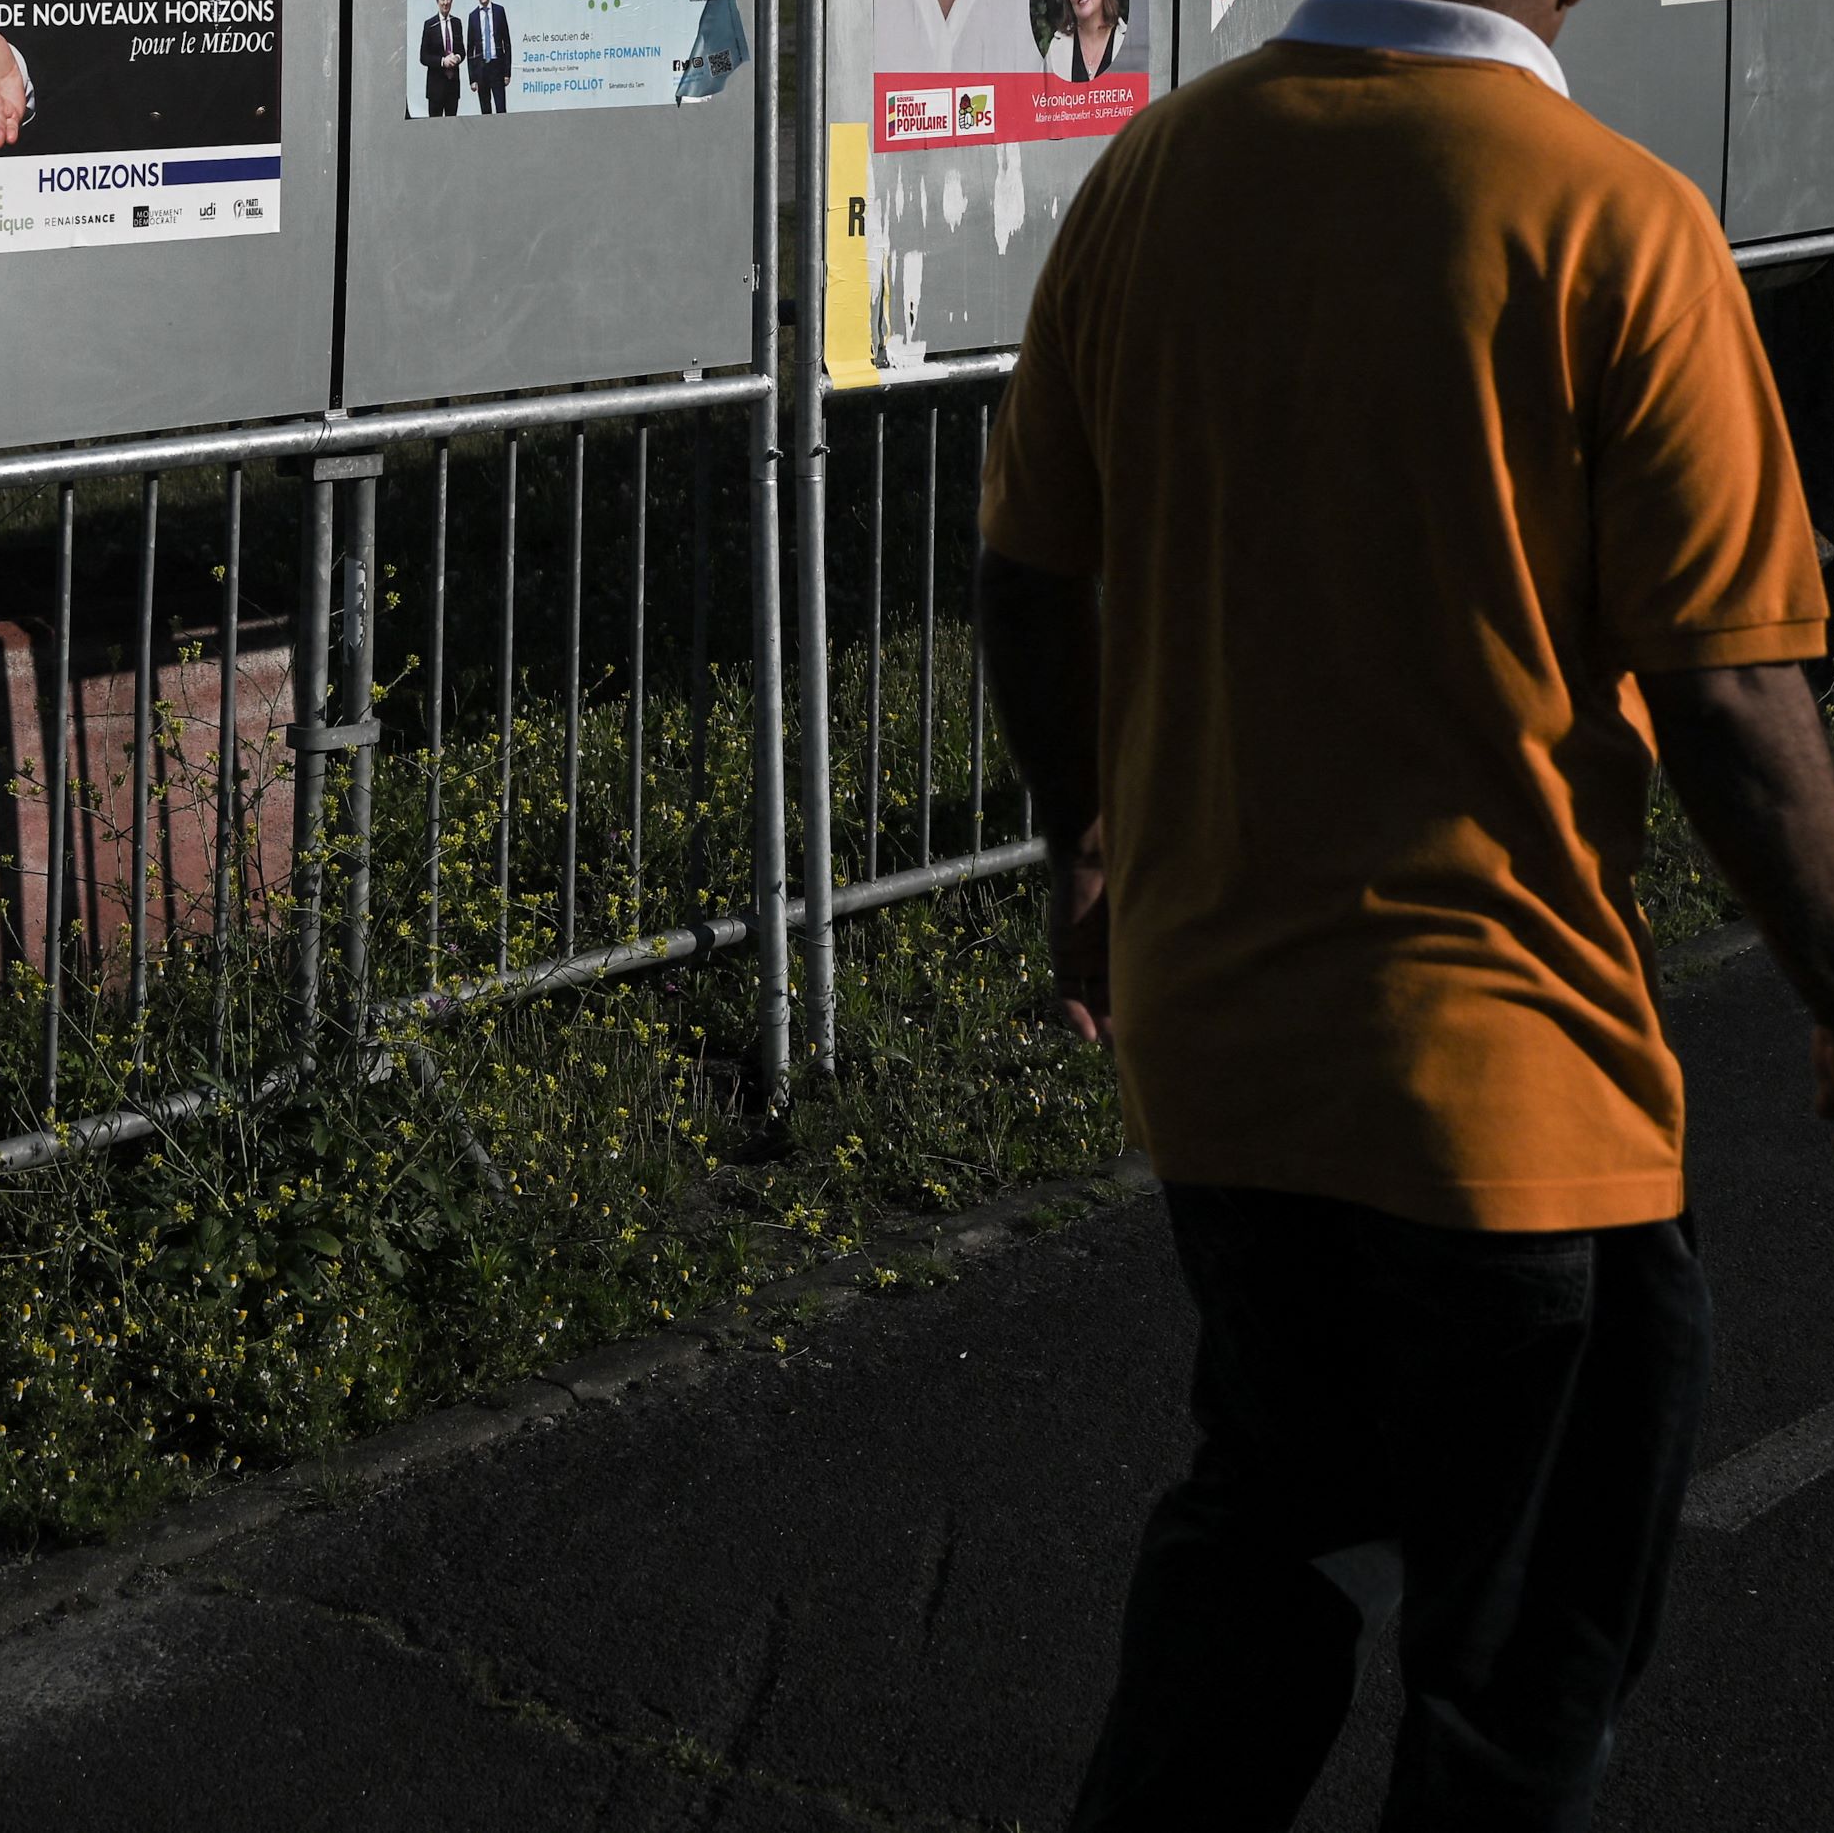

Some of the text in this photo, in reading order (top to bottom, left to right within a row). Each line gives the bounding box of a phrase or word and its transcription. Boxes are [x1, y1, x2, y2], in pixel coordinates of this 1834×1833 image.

[33, 1, 158, 27] NOUVEAUX
[165, 0, 274, 24] HORIZONS
[130, 26, 274, 61] pour le MÉDOC
[523, 31, 578, 43] Avec soutien
[522, 46, 661, 64] Jean-Christophe FROMANTIN
[523, 78, 603, 94] Philippe FOLLIOT
[1031, 88, 1134, 109] Véronique FERREIRA
[896, 102, 927, 118] FRONT
[1095, 105, 1134, 118] SUPPLÉANTE
[896, 115, 947, 132] POPULAIRE
[975, 110, 992, 127] PS
[38, 163, 159, 193] HORIZONS
[136, 208, 183, 218] MOUVEMENT
[199, 202, 216, 216] udi
[44, 213, 115, 227] RENAISSANCE
